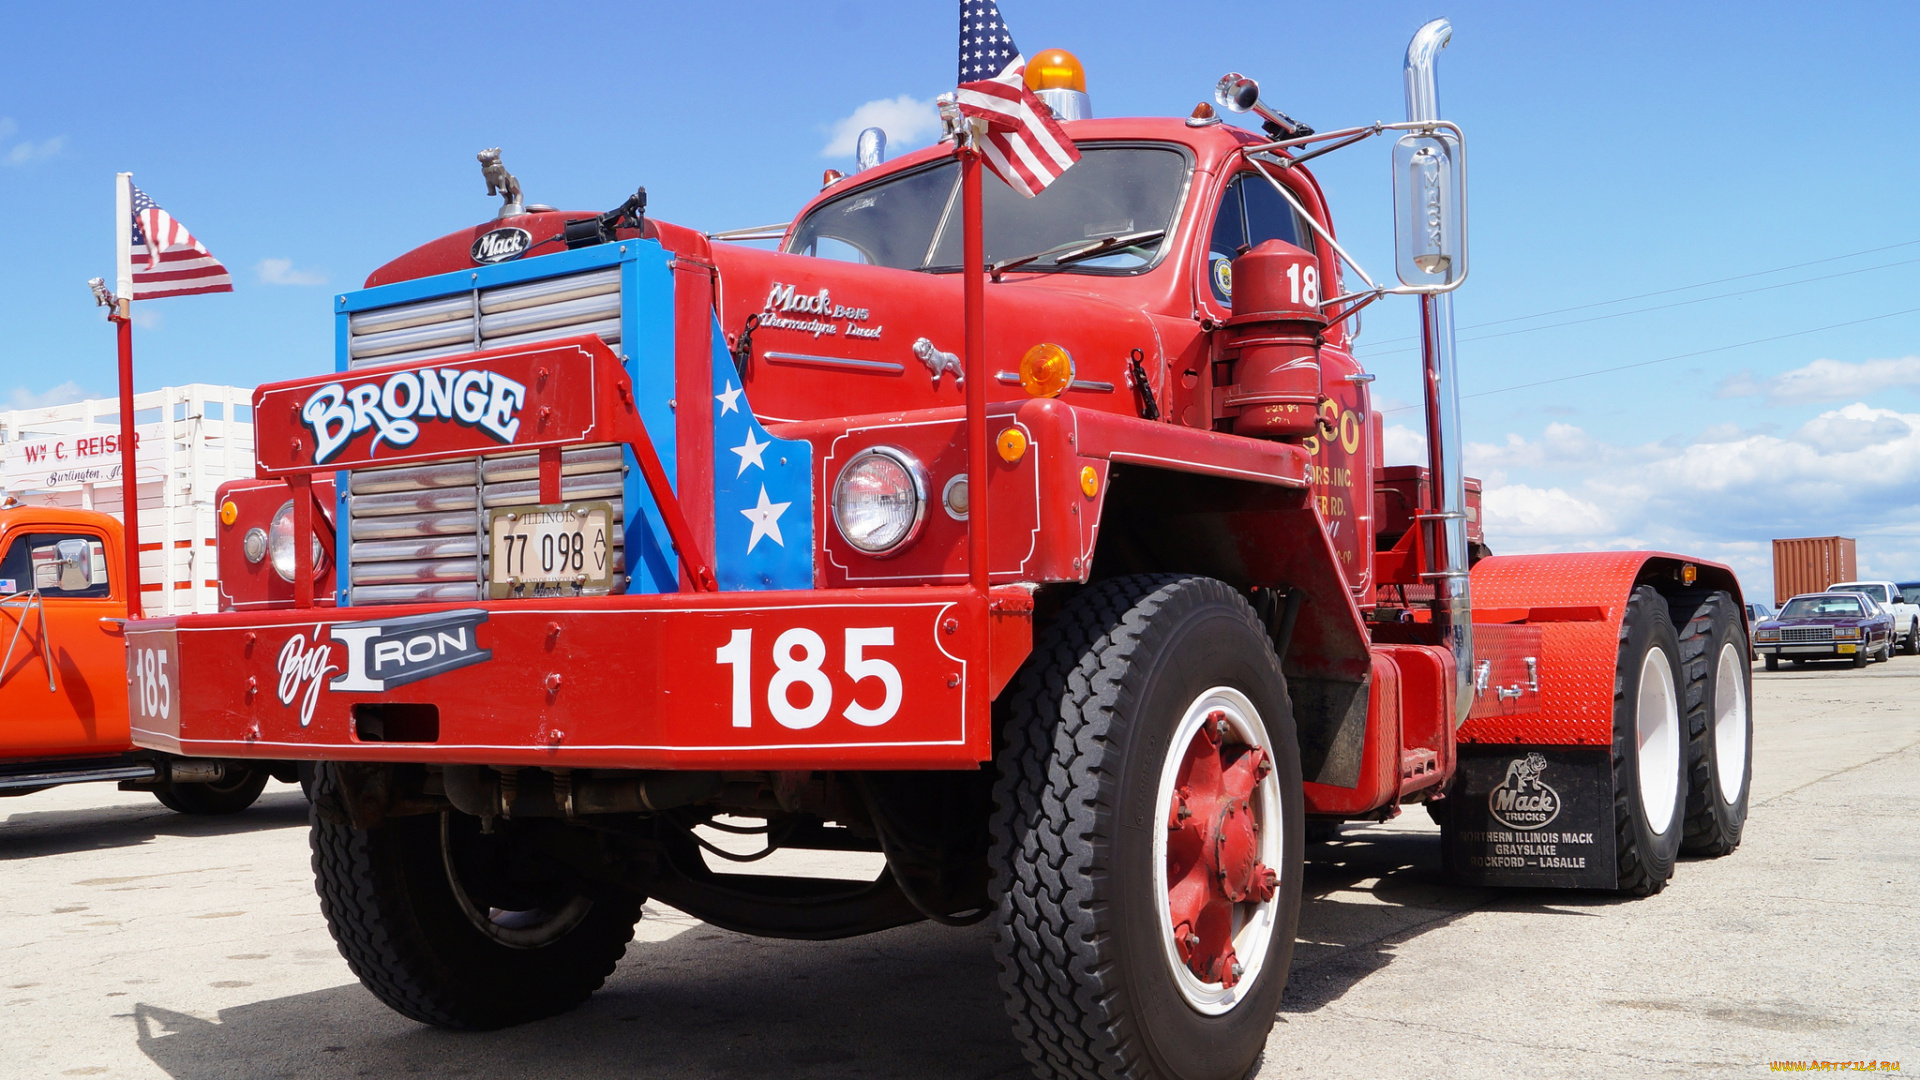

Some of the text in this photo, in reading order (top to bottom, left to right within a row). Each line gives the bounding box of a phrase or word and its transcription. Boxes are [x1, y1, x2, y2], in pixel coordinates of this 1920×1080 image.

[475, 230, 523, 259] Mack
[764, 282, 832, 315] Mack
[759, 312, 837, 338] Thermodyne
[302, 368, 527, 465] BRONGE
[56, 441, 68, 460] C.
[523, 510, 576, 525] ILLINOIS
[1330, 496, 1346, 516] RD.
[503, 533, 528, 574] 77
[542, 531, 584, 573] 098
[136, 647, 171, 720] 185
[277, 622, 339, 728] Big
[716, 627, 903, 729] 185
[1495, 789, 1555, 812] Mack
[1505, 812, 1546, 821] TRUCKS
[1460, 831, 1593, 844] NORTHERN ILLINOIS MACK
[1495, 844, 1556, 856] GRAYSLAKE
[1471, 857, 1525, 868] ROCKFORD
[1540, 857, 1585, 868] LASALLE
